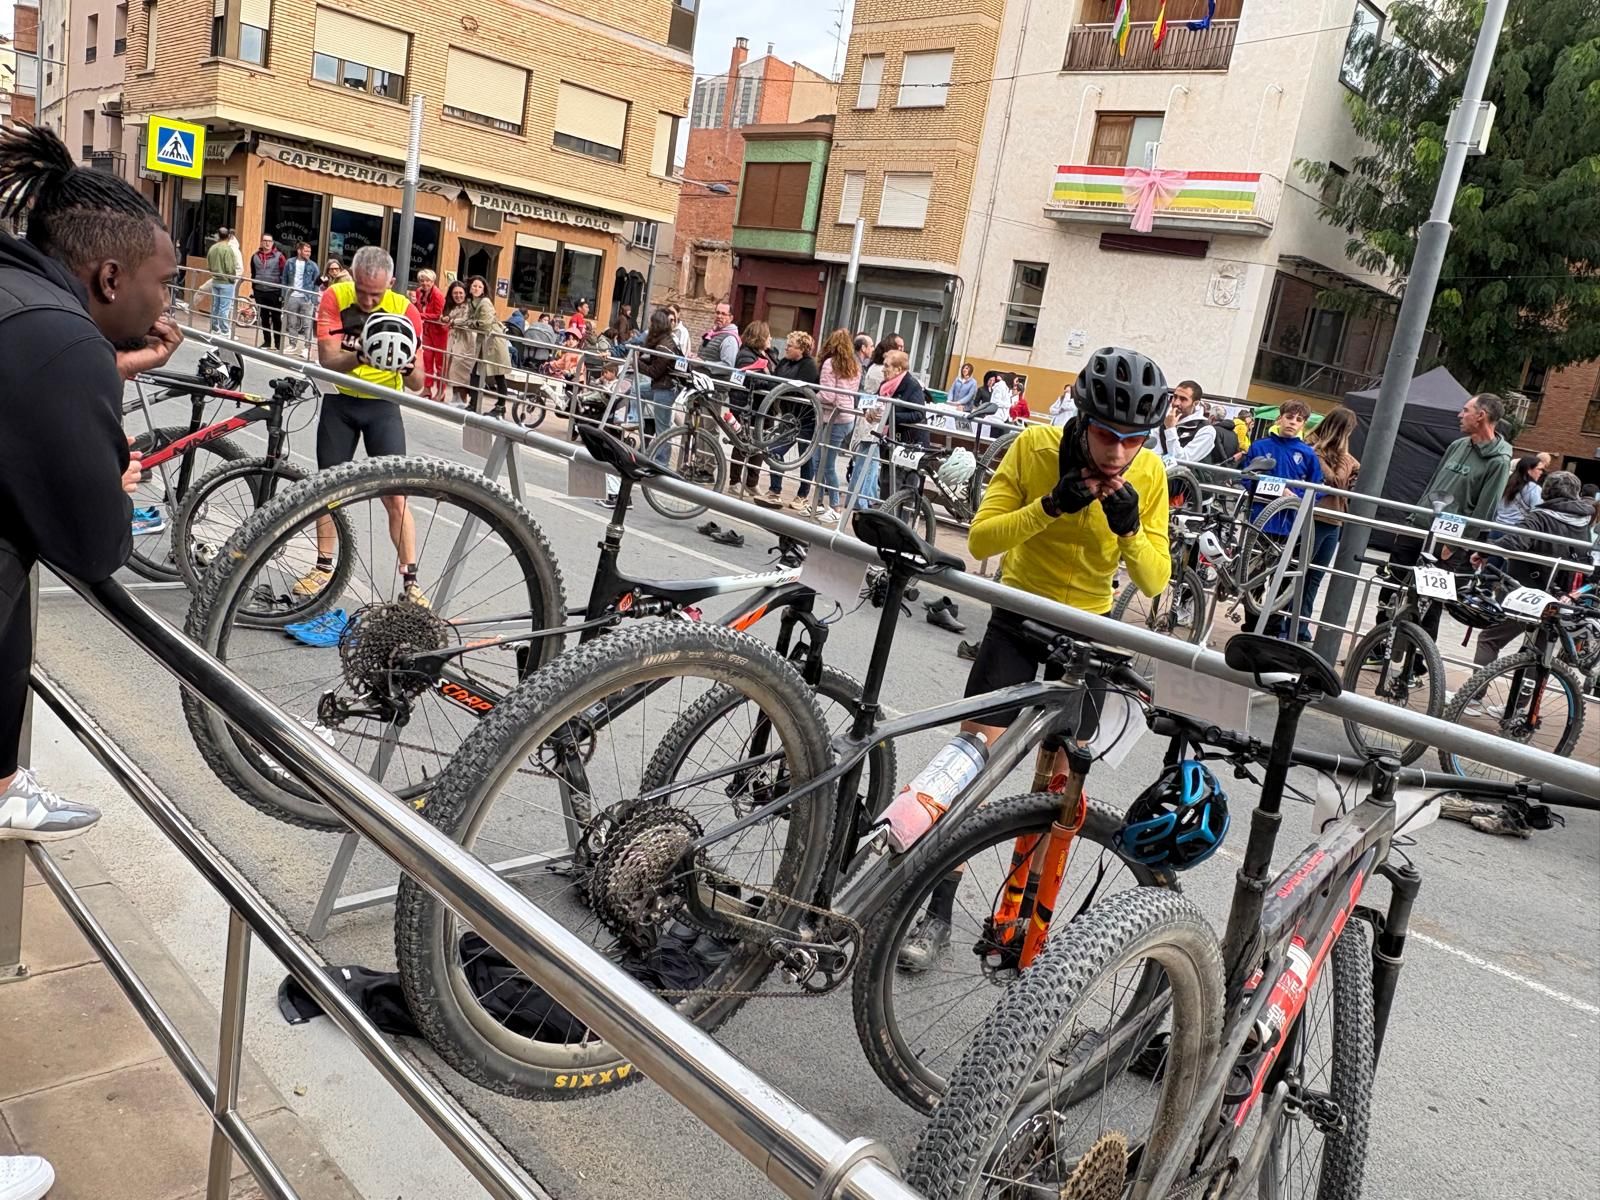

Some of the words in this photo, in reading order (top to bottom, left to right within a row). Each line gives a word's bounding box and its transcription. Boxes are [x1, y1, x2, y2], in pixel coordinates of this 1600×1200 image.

[278, 150, 389, 184] CAFETERIA
[395, 177, 442, 193] GLO
[480, 195, 569, 222] PANADERIA
[574, 213, 610, 230] GALO
[1262, 482, 1280, 493] 130
[1438, 520, 1460, 533] 128
[1422, 574, 1448, 590] 128
[1516, 591, 1542, 606] 126
[553, 1063, 632, 1088] AXXIS
